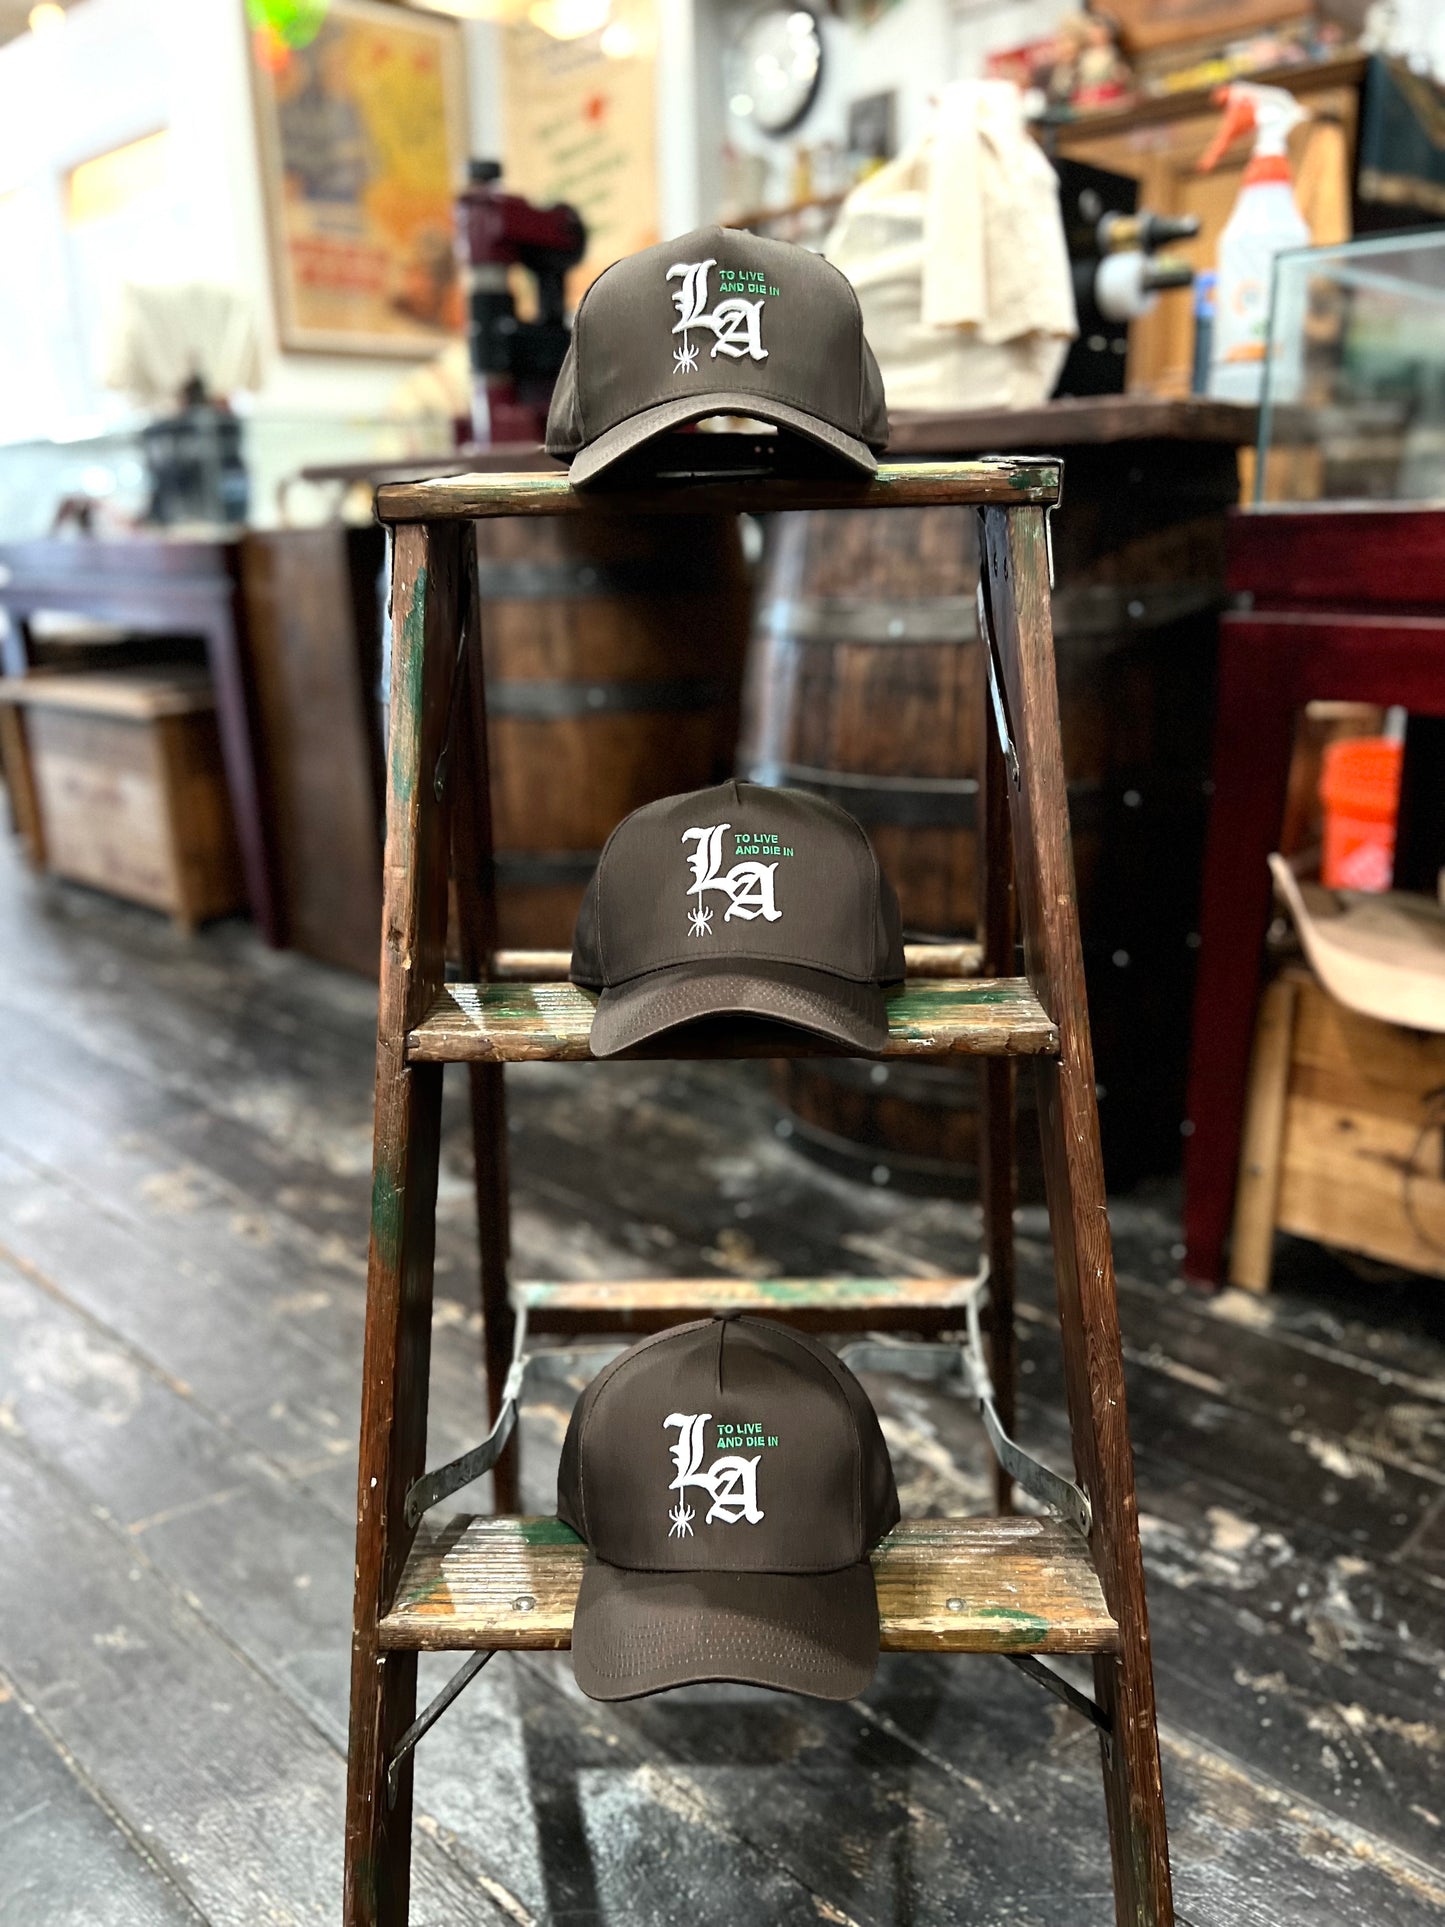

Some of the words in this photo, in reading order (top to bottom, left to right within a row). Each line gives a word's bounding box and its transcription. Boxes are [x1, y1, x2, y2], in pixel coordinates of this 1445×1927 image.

[719, 270, 735, 280] TO
[738, 271, 765, 282] LIVE
[719, 282, 745, 292] AND
[748, 283, 767, 295] DIE
[769, 286, 780, 296] IN
[734, 834, 751, 844] TO
[753, 834, 779, 844] LIVE
[735, 845, 761, 855] AND
[762, 846, 781, 855] DIE
[783, 847, 794, 857] IN
[716, 1424, 734, 1435] TO
[736, 1423, 762, 1435] LIVE
[716, 1436, 743, 1449] AND
[746, 1436, 765, 1447] DIE
[767, 1436, 779, 1447] IN
